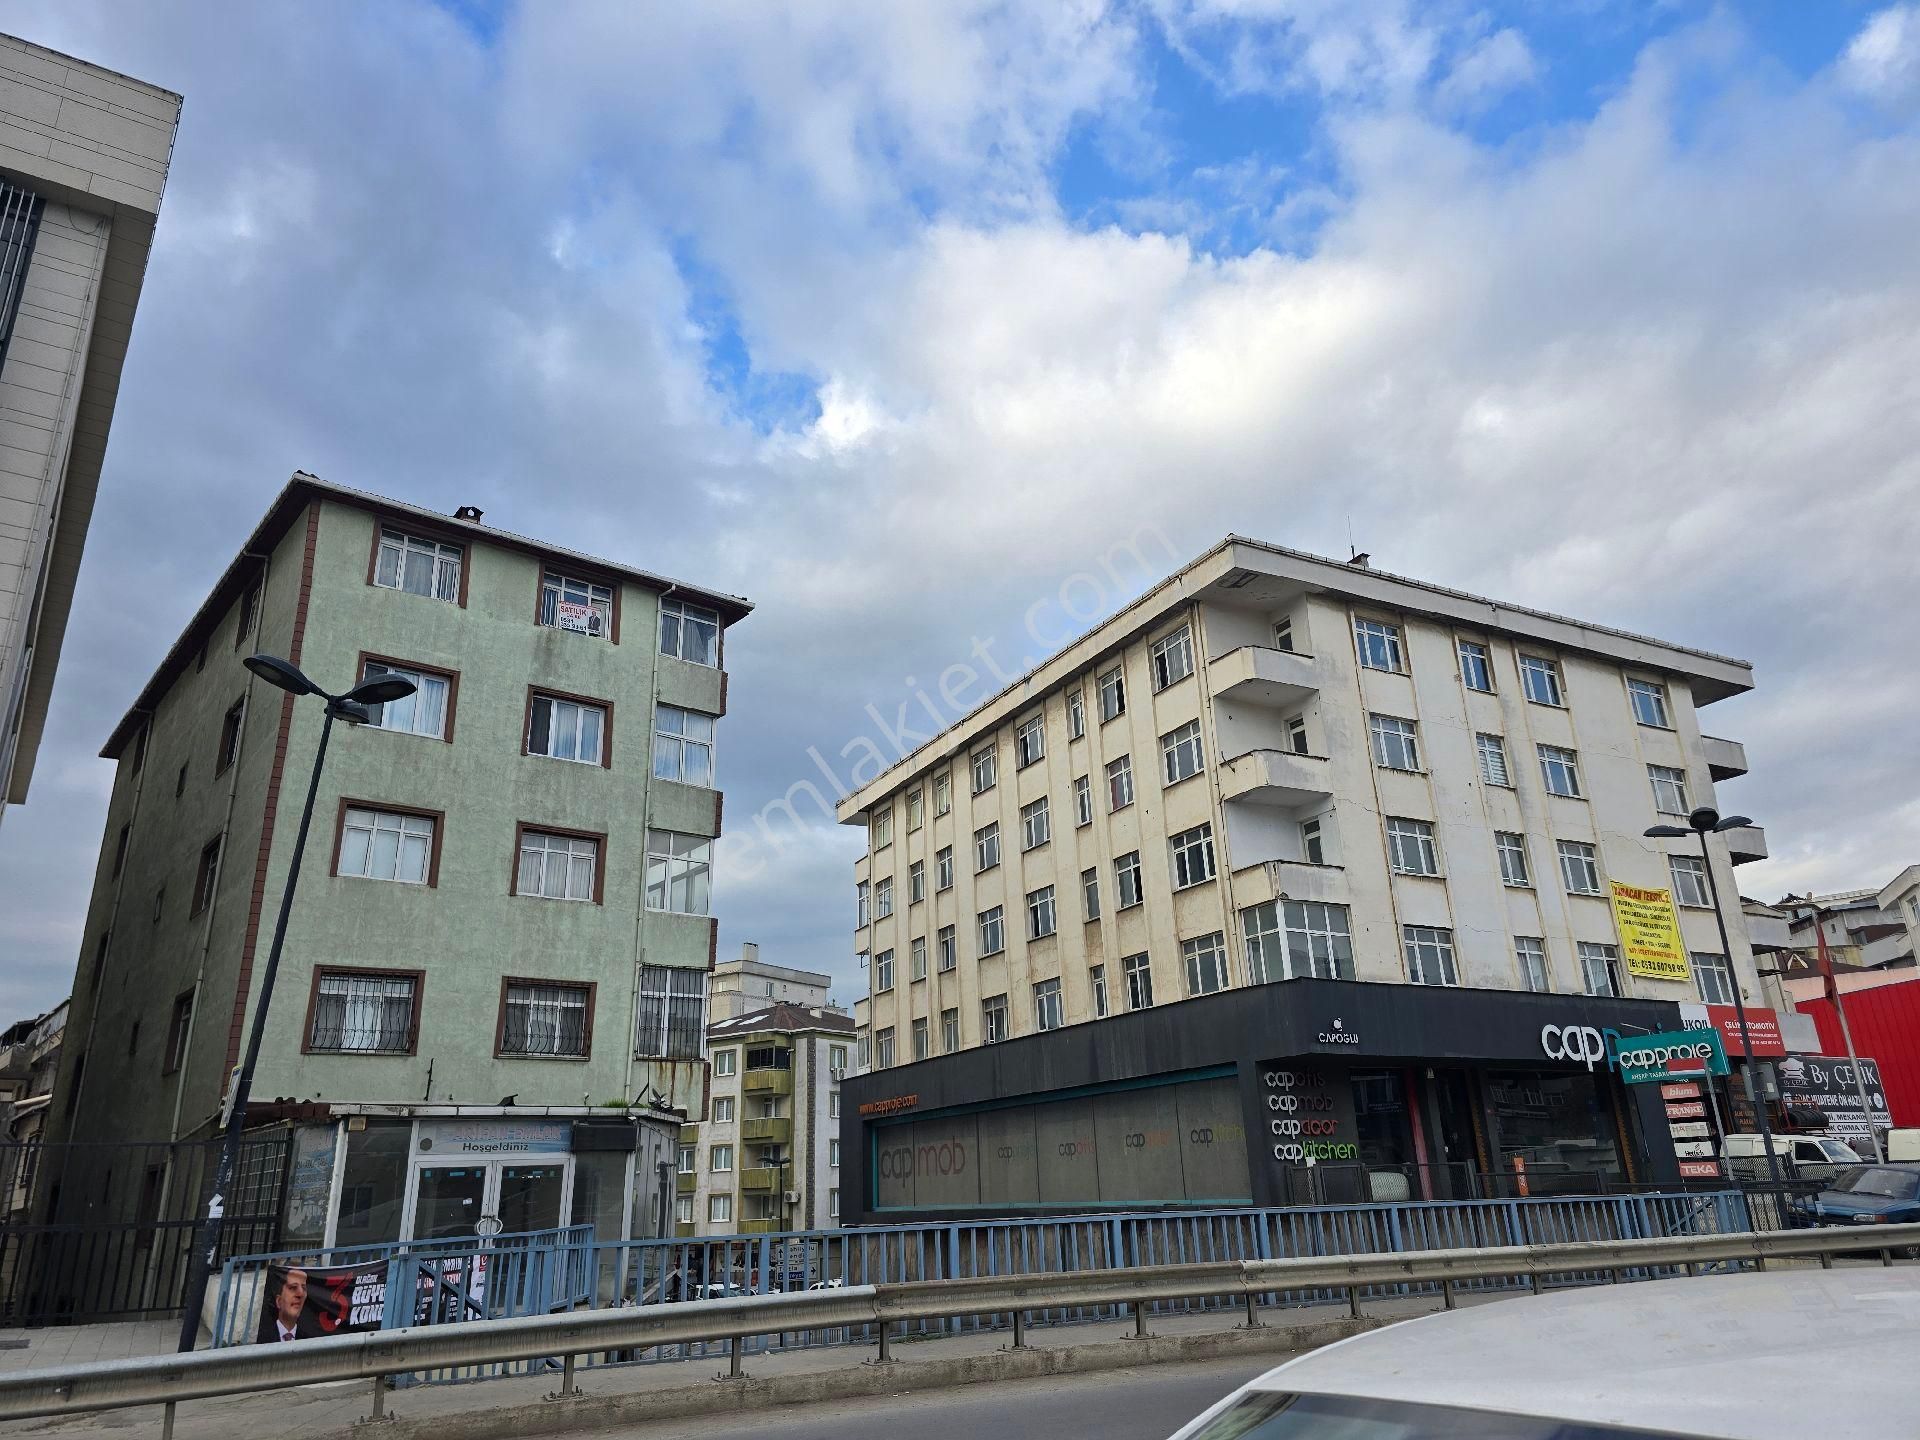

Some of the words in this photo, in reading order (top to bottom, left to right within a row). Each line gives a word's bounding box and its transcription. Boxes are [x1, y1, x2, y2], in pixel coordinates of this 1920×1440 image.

[560, 605, 587, 616] SATILIK
[1809, 1064, 1829, 1090] By
[1834, 1061, 1878, 1090] ÇEİK
[1669, 1087, 1693, 1097] blum
[1667, 1104, 1704, 1115] FRANKE
[462, 1142, 529, 1153] Hoşgeldiniz
[1681, 1164, 1716, 1175] TEKA
